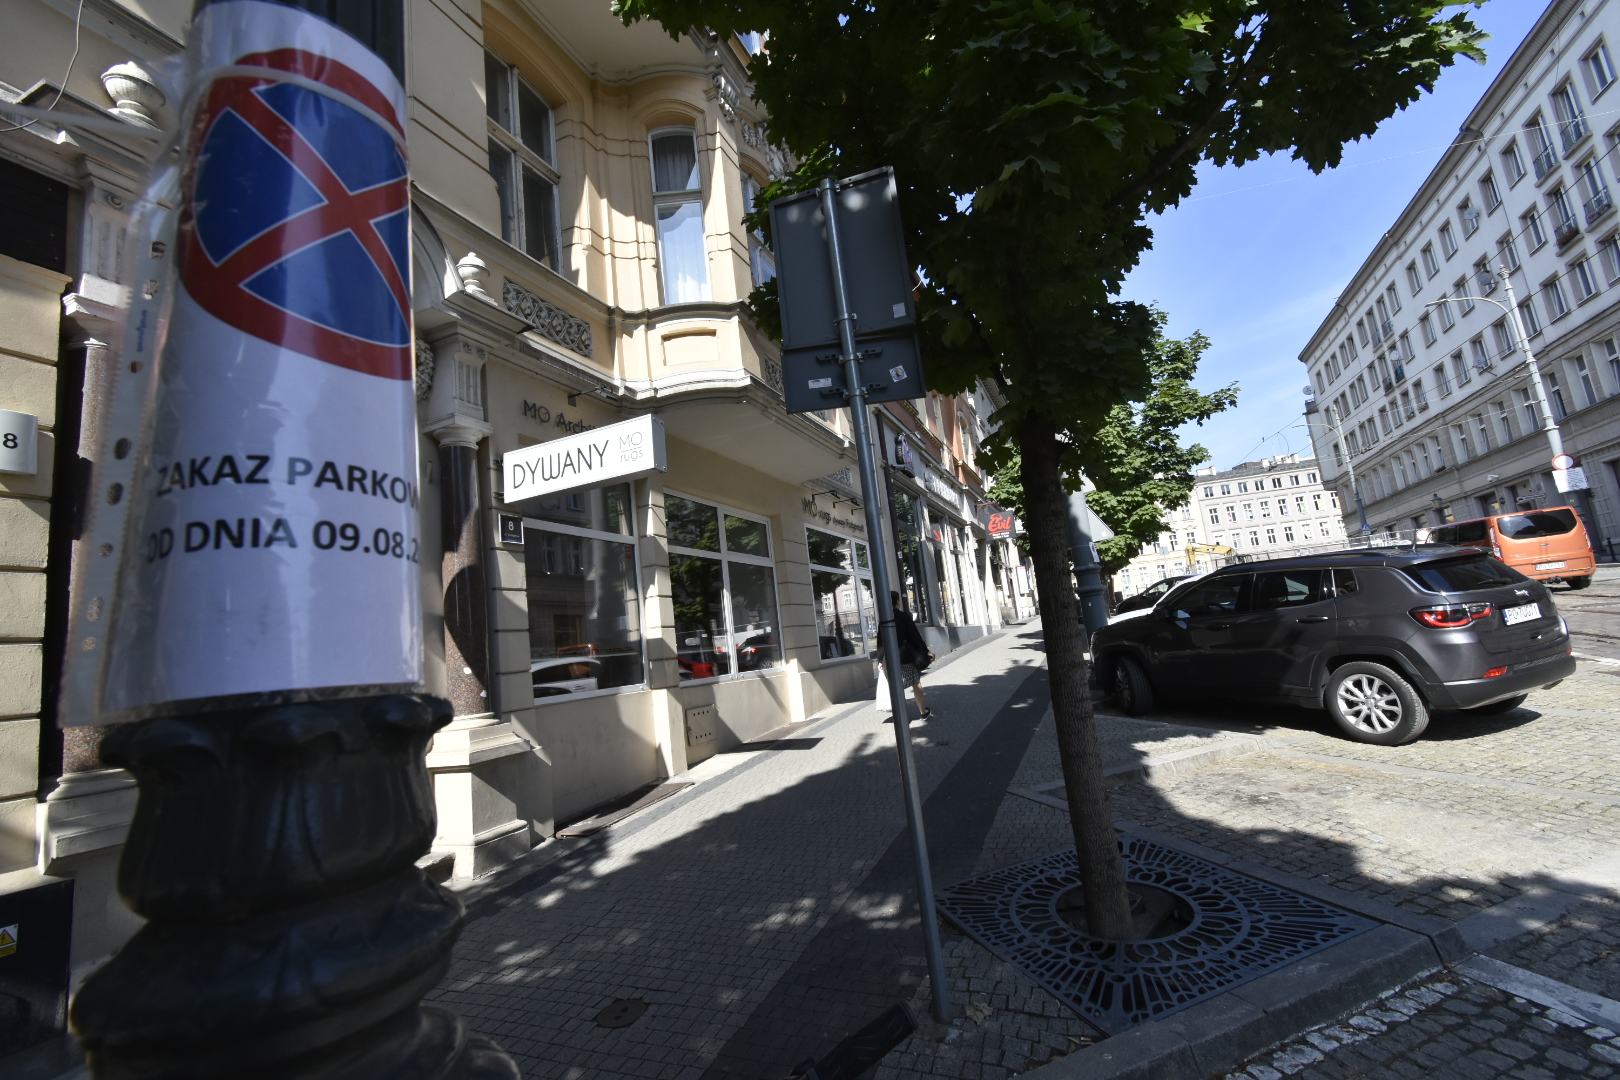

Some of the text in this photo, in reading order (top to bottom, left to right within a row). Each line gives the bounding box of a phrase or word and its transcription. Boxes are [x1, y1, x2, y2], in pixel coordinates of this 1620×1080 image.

[523, 399, 551, 423] MO
[2, 432, 19, 449] 8
[619, 432, 642, 449] MO
[513, 440, 609, 489] DYWANY
[620, 450, 643, 462] rugs
[156, 454, 270, 497] ZAKAZ
[508, 521, 514, 531] 8
[988, 513, 1012, 531] Evil
[184, 518, 298, 553] DNIA
